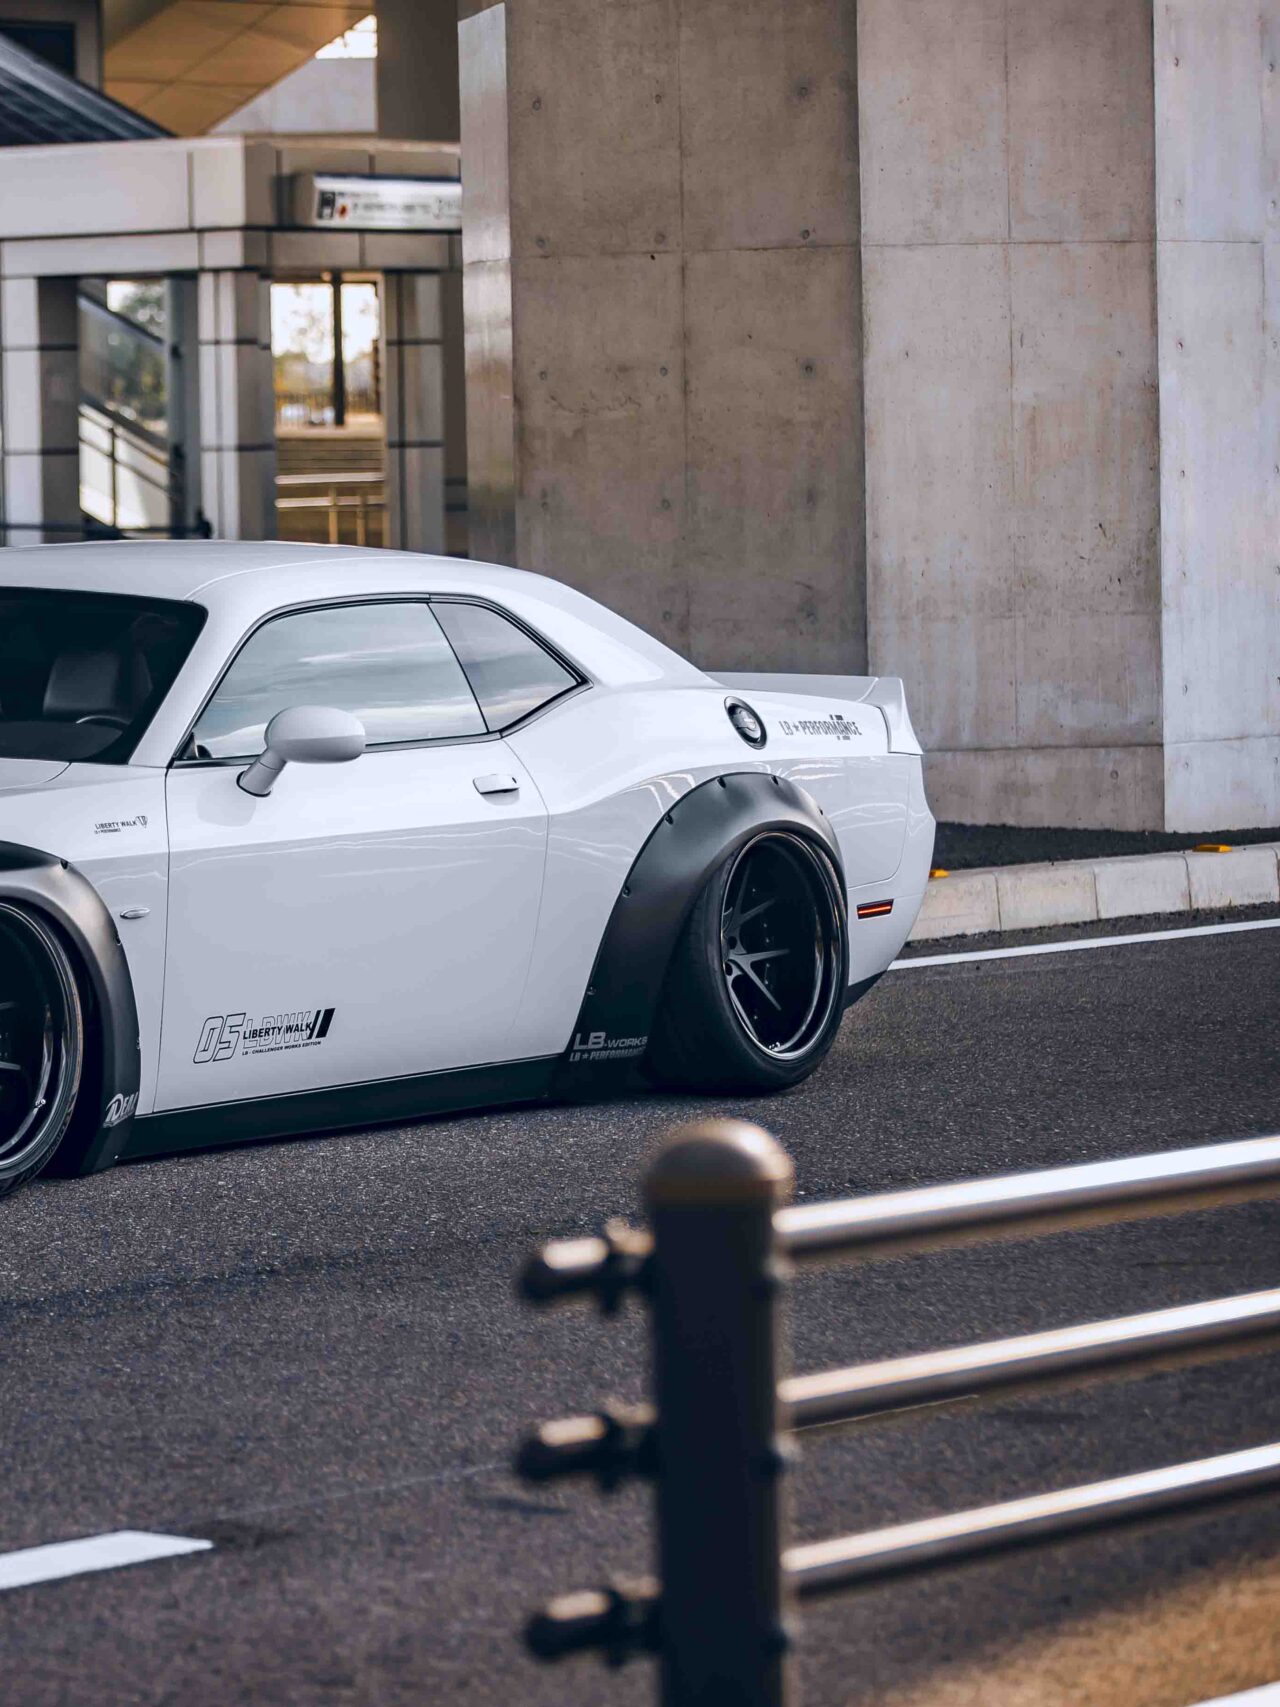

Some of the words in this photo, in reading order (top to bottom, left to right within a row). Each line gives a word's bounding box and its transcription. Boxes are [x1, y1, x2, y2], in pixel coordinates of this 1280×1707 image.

[778, 720, 794, 736] LB
[798, 720, 862, 736] PERFORMANCE
[94, 822, 120, 830] LIBERTY
[242, 1025, 283, 1040] LIBERTY
[285, 1021, 313, 1034] WALK
[252, 1046, 283, 1055] CHALLENGER
[302, 1040, 322, 1048] EDITION
